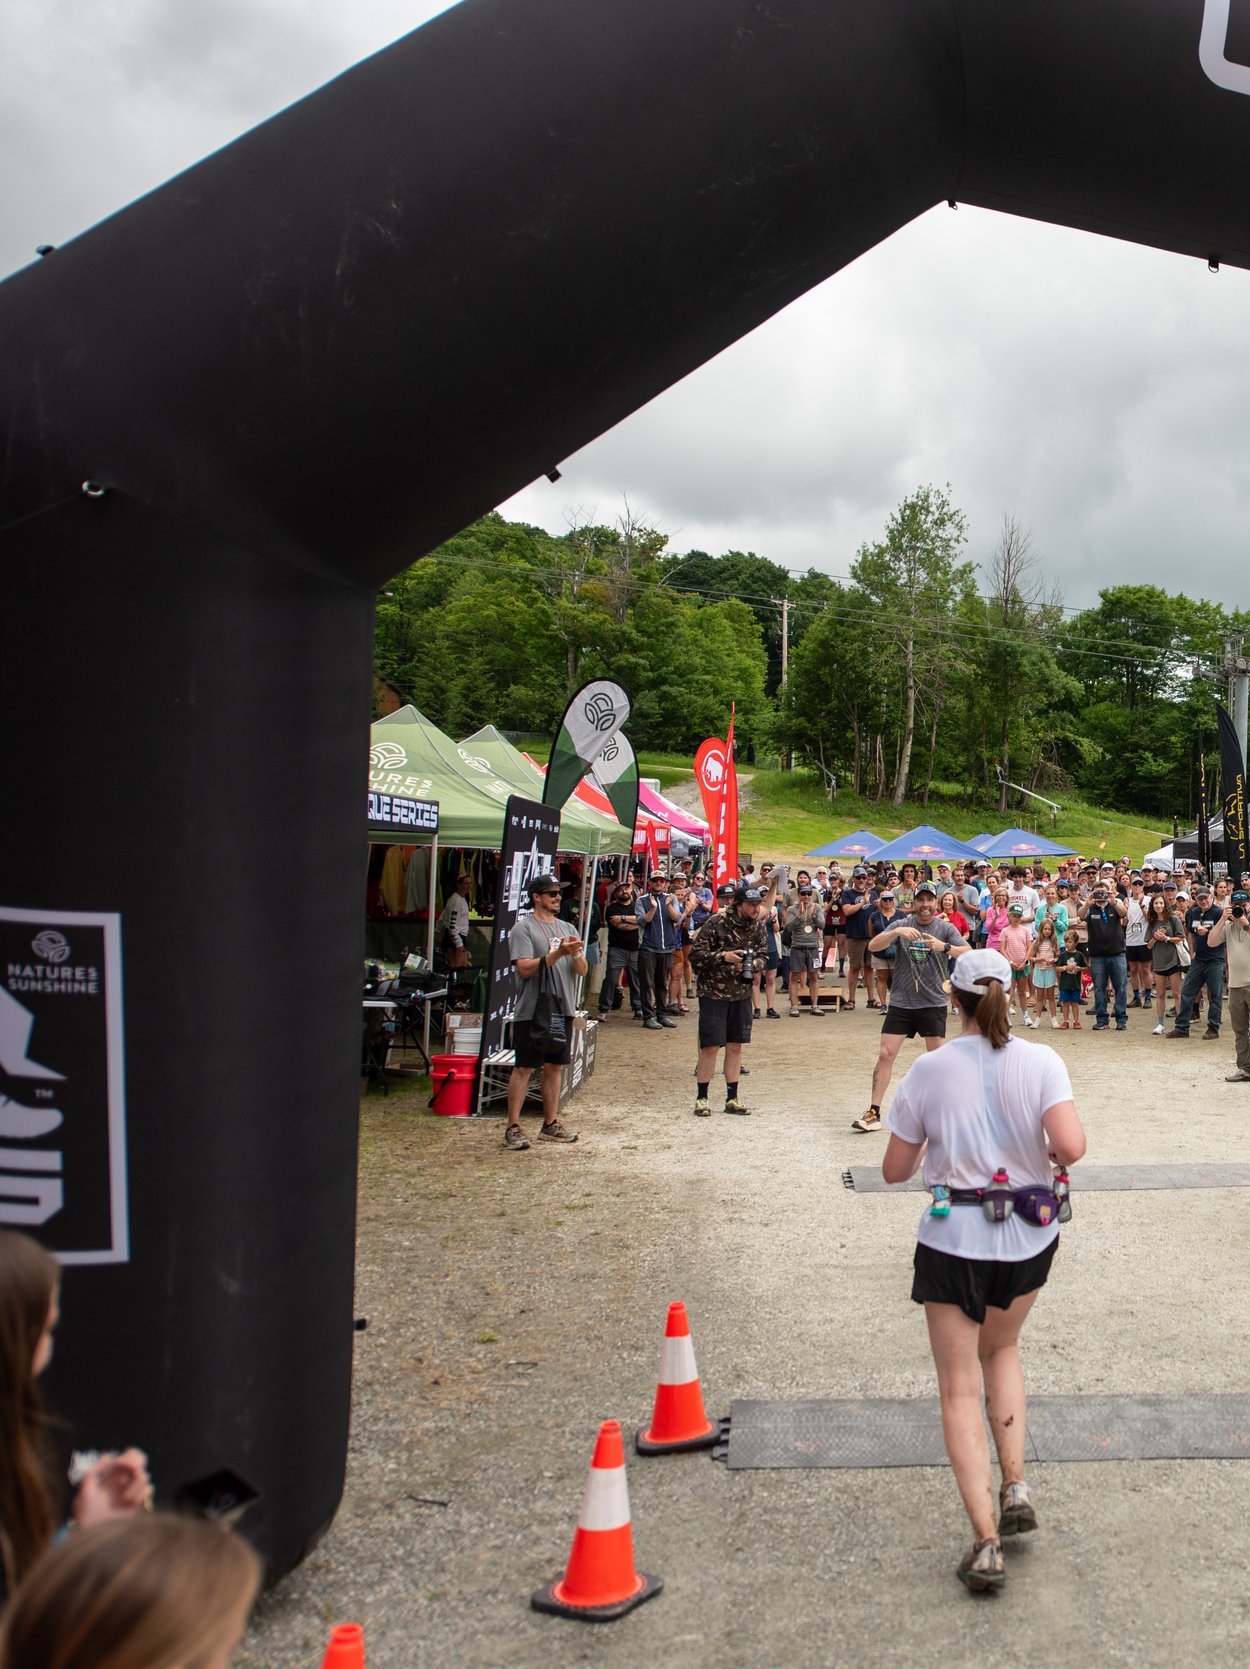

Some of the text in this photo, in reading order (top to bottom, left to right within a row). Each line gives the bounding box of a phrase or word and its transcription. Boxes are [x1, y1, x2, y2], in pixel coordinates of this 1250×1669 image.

[369, 771, 433, 788] URES
[368, 793, 438, 828] QUE SERIES
[7, 963, 99, 980] NATURES
[7, 978, 99, 994] SUNSHINE
